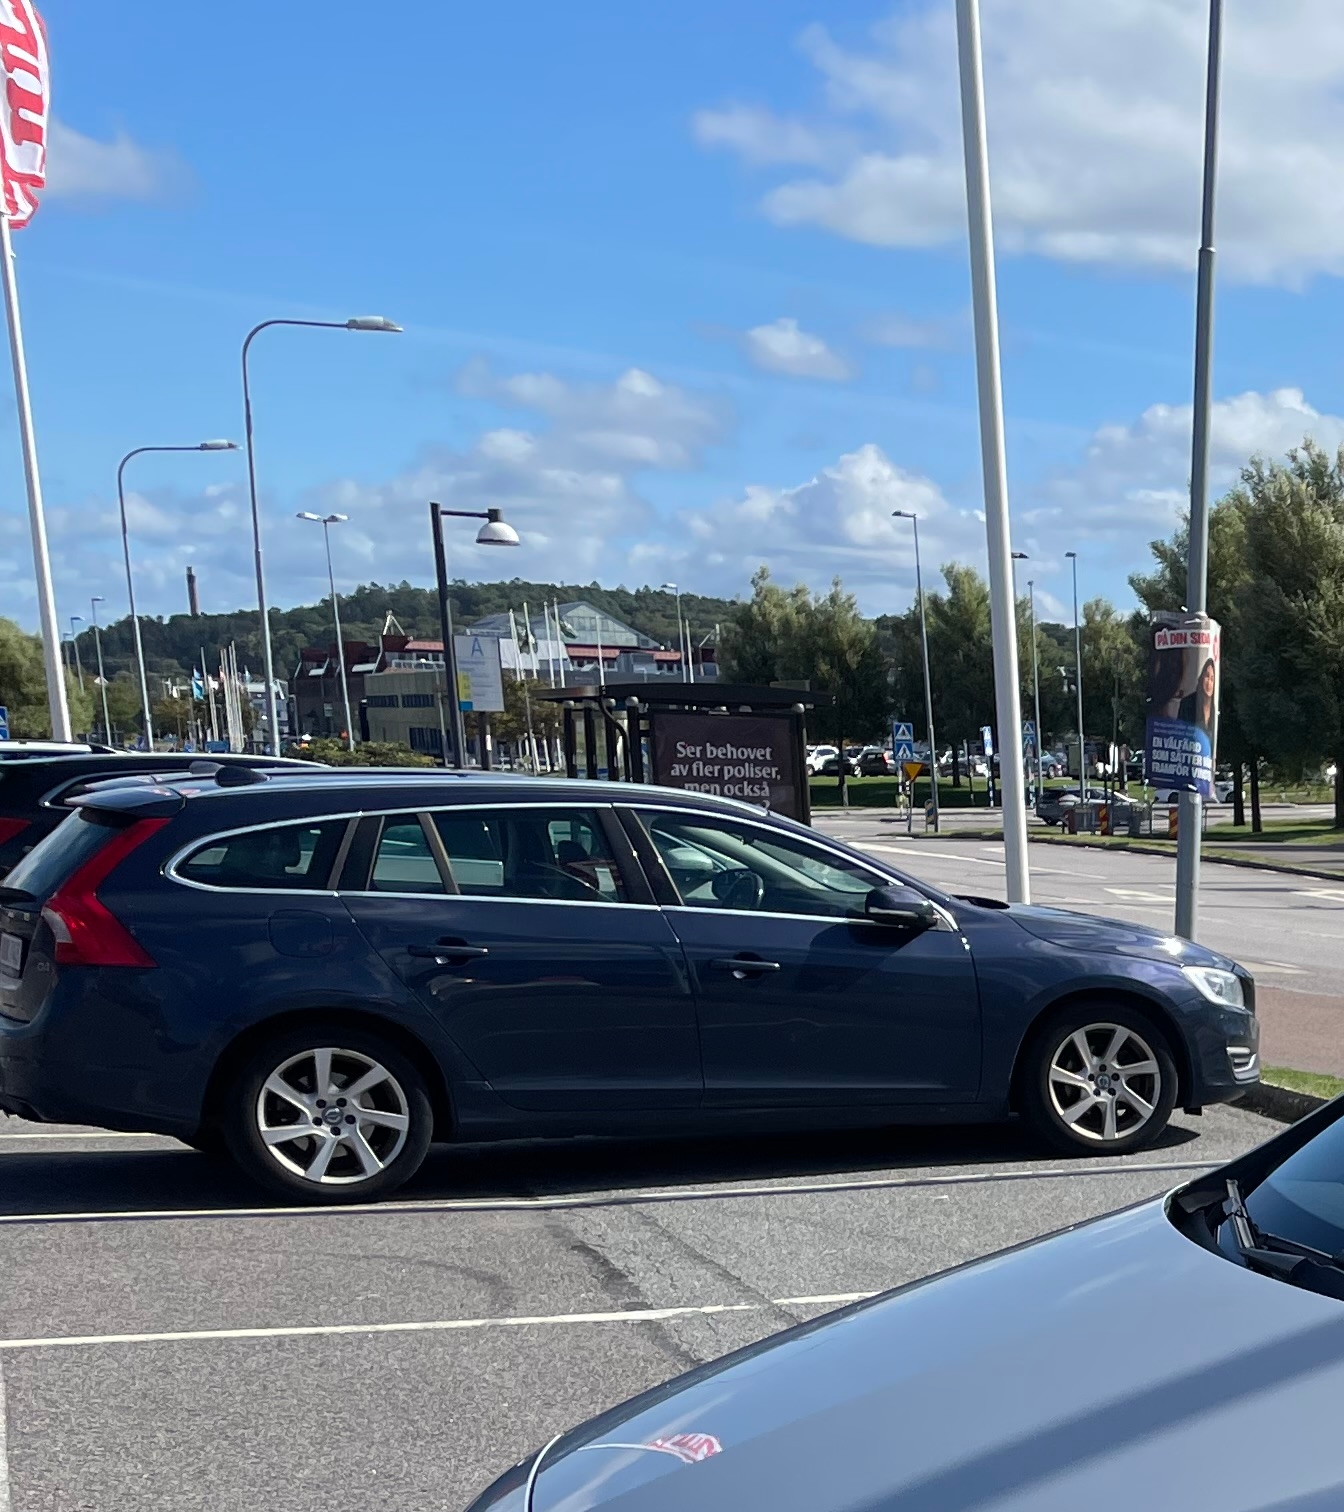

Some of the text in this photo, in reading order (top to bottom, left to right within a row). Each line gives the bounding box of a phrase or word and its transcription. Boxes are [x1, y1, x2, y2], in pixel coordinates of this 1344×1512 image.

[471, 637, 484, 657] A
[1170, 632, 1187, 645] DIN
[676, 741, 772, 761] Ser behovet
[670, 761, 781, 781] av fler poliser,
[724, 780, 770, 797] också
